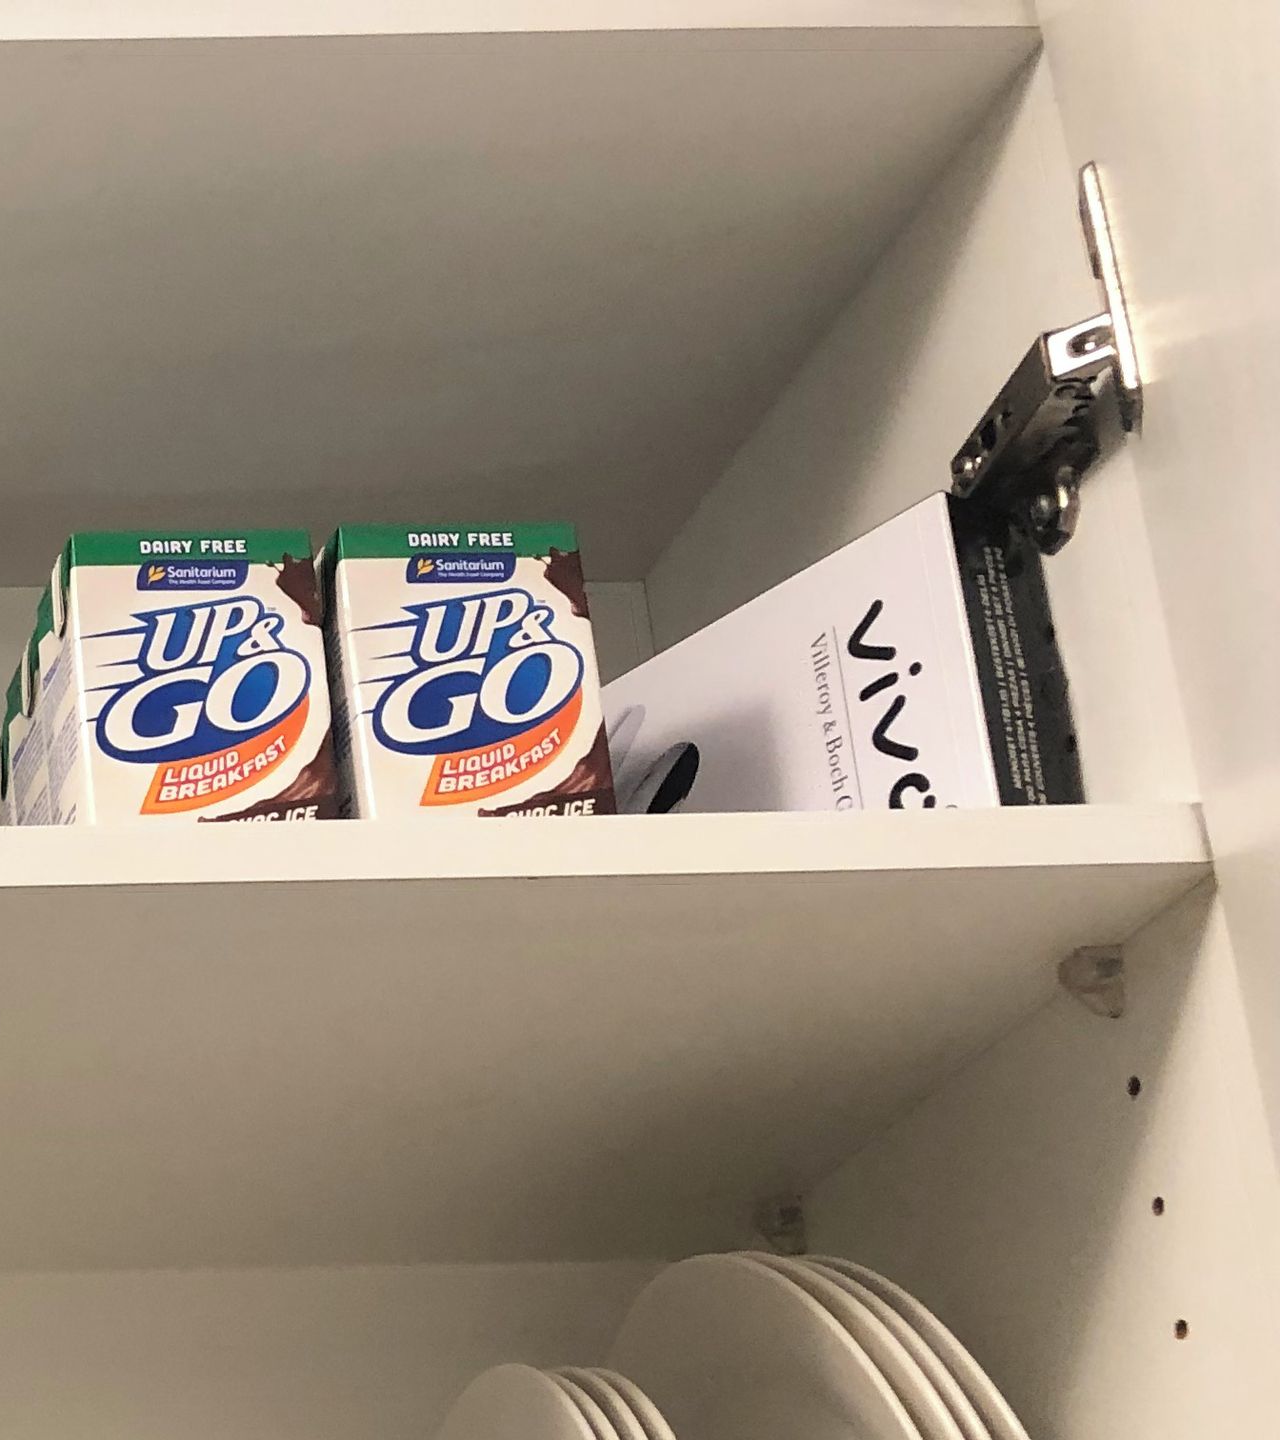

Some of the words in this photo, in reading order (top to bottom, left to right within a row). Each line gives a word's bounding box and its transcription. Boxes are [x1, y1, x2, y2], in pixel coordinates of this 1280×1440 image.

[140, 540, 192, 554] DAIRY
[200, 540, 247, 553] FREE
[408, 533, 459, 547] DAIRY
[467, 533, 514, 547] FREE
[167, 566, 236, 578] Sanitarium
[435, 559, 504, 571] Sanitarium
[810, 632, 833, 716] Villeroy
[104, 651, 307, 752] GO
[381, 642, 580, 743] GO
[823, 720, 837, 733] &
[159, 735, 287, 801] BREAKFAST
[164, 751, 239, 783] LIQUID
[438, 728, 562, 793] BREAKFAST
[443, 743, 516, 775] LIQUID
[826, 735, 849, 792] Boch
[564, 797, 596, 816] ICE
